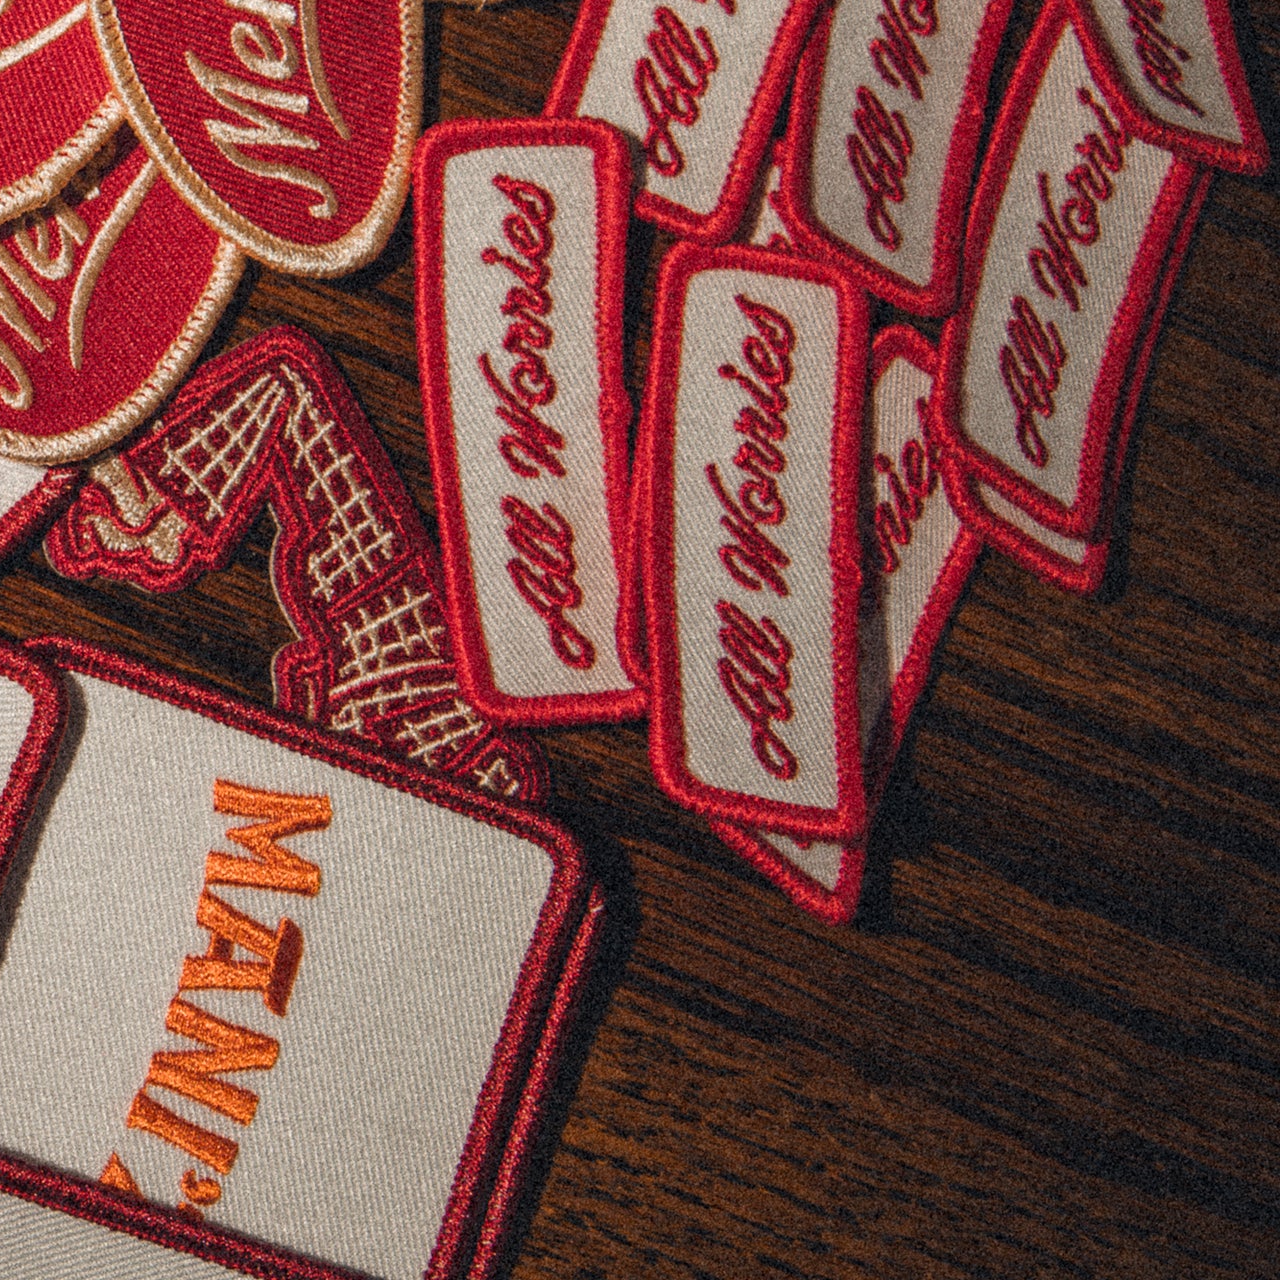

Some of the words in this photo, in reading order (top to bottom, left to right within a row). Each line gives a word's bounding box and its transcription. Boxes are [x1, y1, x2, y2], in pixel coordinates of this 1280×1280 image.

[635, 7, 717, 177] All
[847, 86, 914, 252] All
[479, 173, 567, 478] Worries
[997, 296, 1068, 468] All
[707, 293, 799, 598] Worries
[501, 497, 596, 671] All
[716, 601, 798, 782] All
